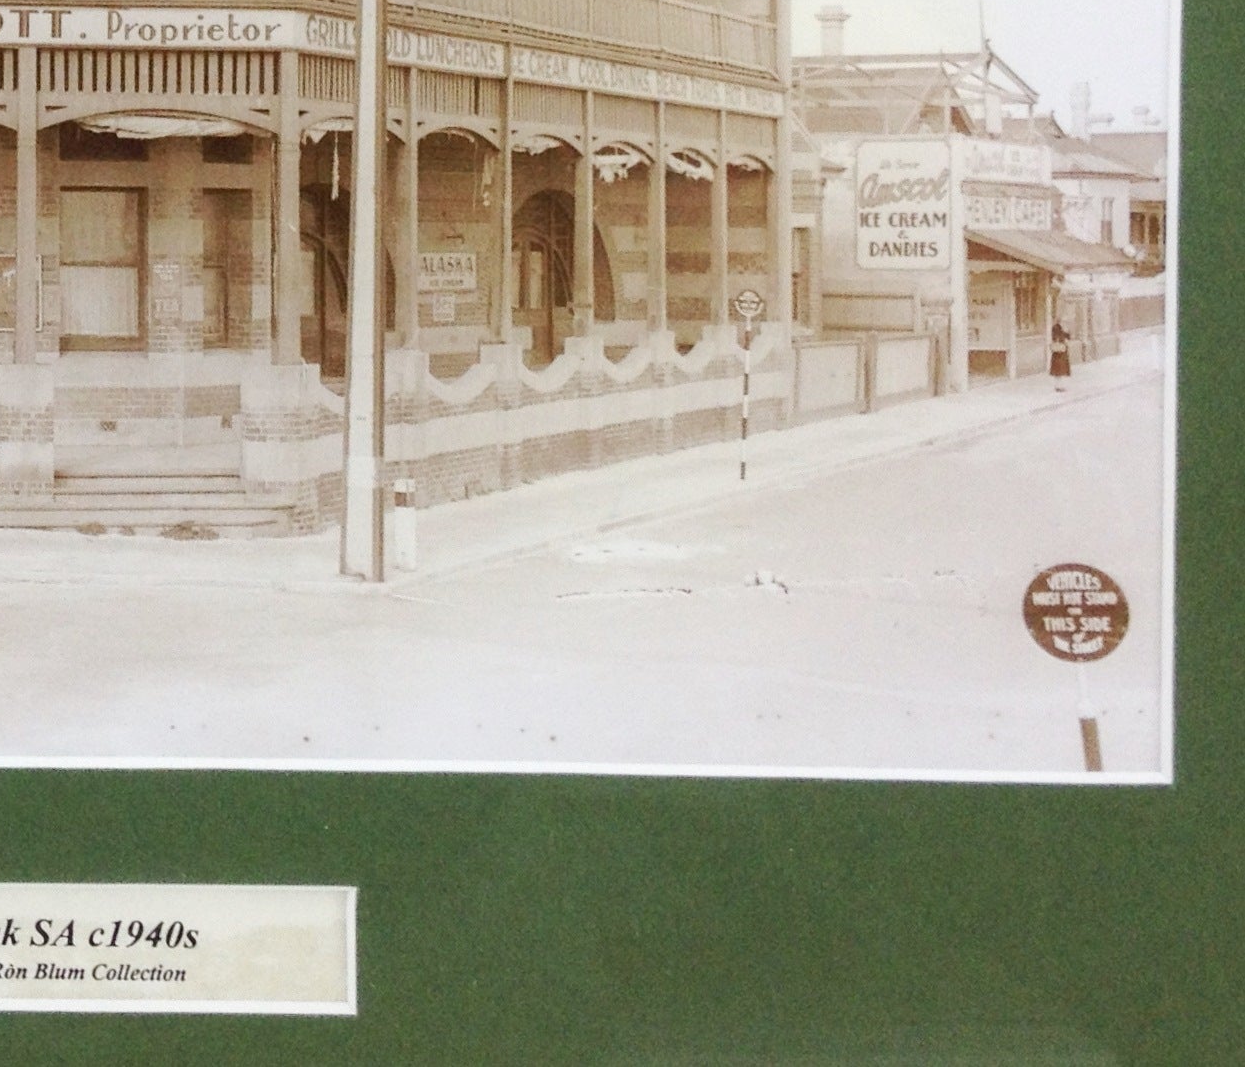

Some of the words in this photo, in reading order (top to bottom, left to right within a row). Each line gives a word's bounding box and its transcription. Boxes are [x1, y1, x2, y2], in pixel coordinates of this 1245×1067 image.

[107, 10, 281, 45] Proprietor
[306, 13, 356, 50] GRILL
[859, 212, 880, 228] ICE
[889, 211, 946, 228] CREAM
[869, 241, 938, 257] DANDIES
[420, 256, 474, 274] ALASKA
[1042, 616, 1076, 632] THIS
[1079, 616, 1112, 632] SIDE
[29, 919, 77, 948] SA
[89, 920, 199, 949] c1940s
[35, 962, 86, 981] Blum
[92, 963, 187, 982] Collection
